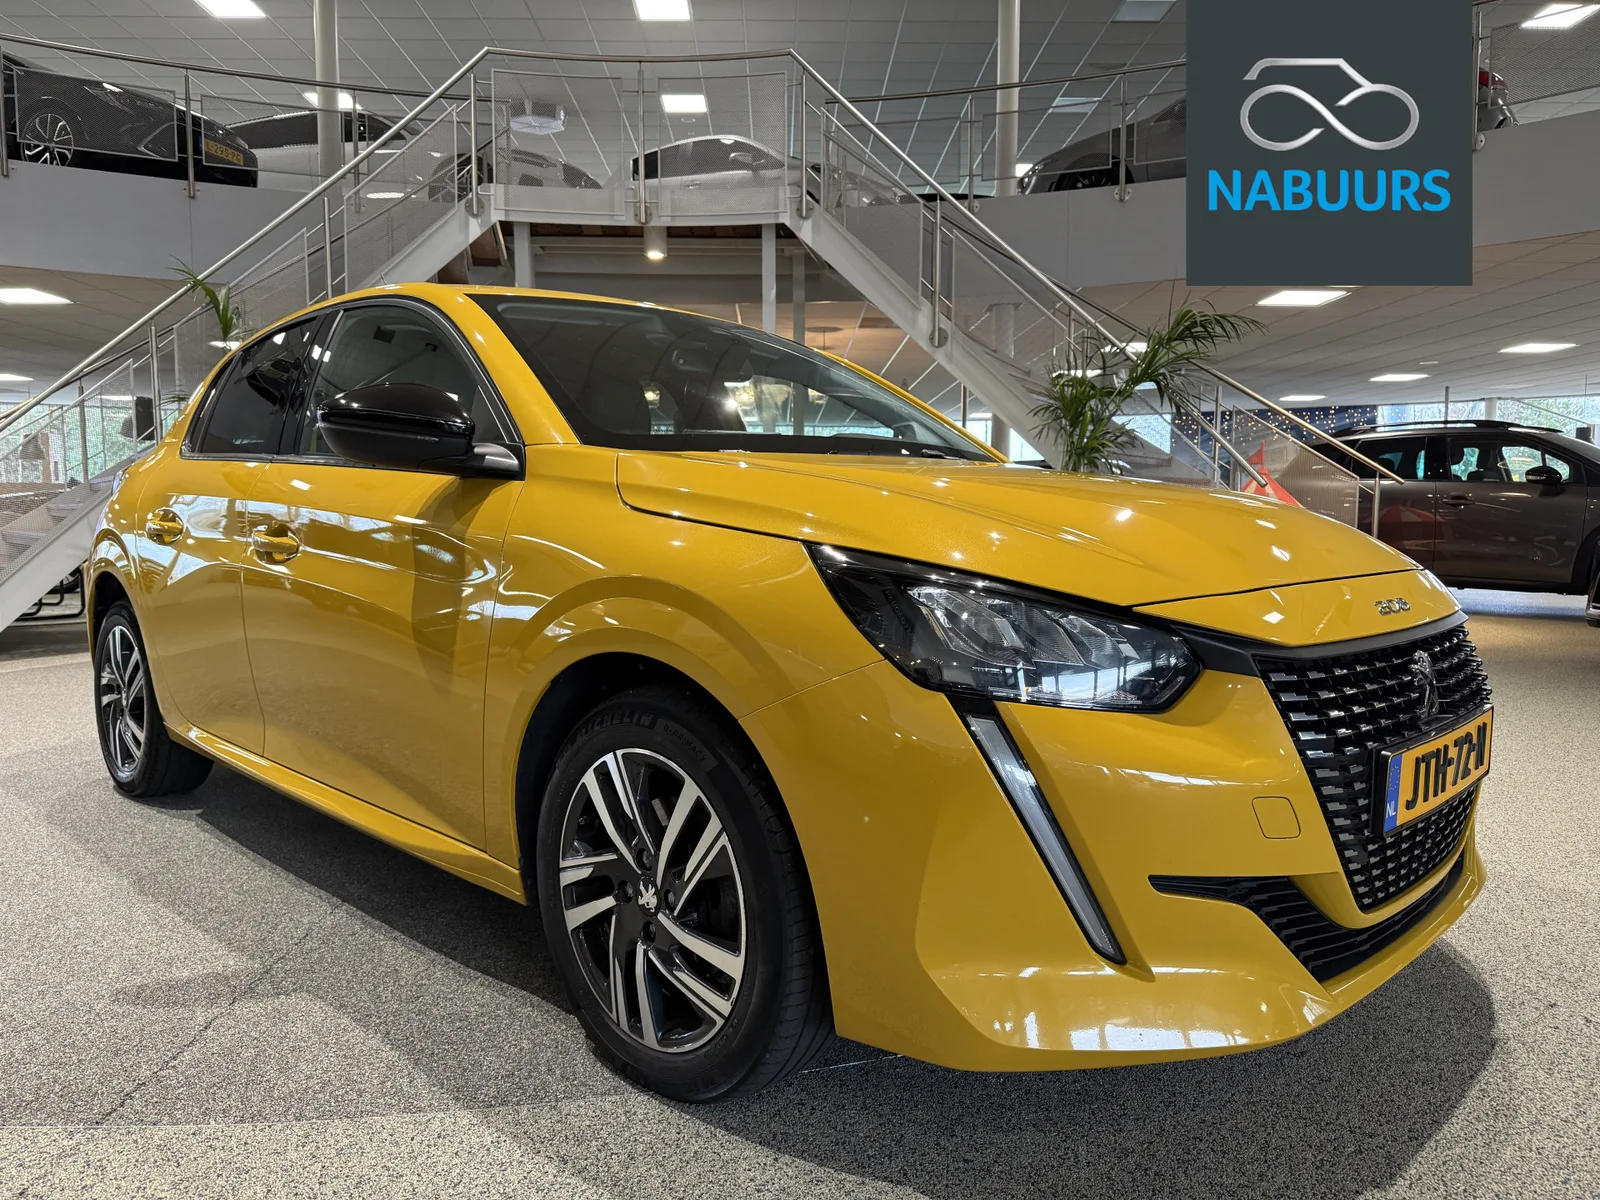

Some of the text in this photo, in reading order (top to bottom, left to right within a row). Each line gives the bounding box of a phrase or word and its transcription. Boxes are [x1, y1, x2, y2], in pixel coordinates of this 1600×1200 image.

[1373, 597, 1411, 615] 208
[575, 710, 654, 742] MICHELIN
[1405, 721, 1488, 811] JTH-72-N
[1385, 800, 1396, 818] NL
